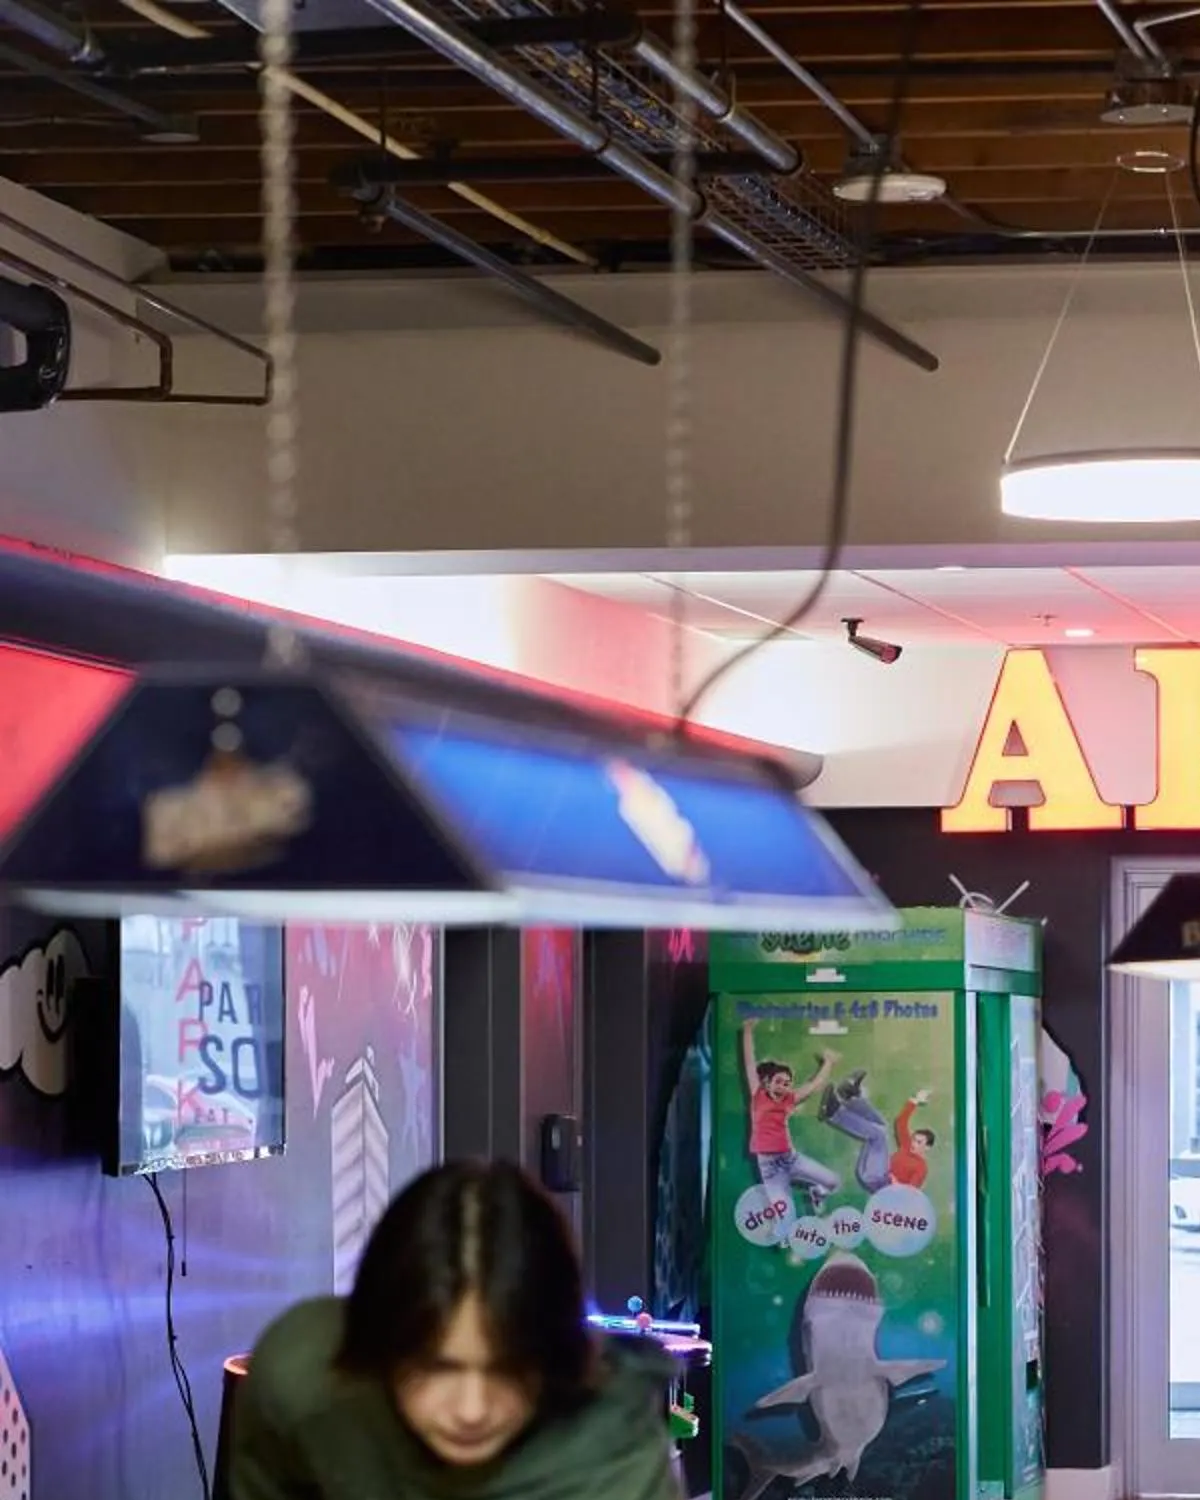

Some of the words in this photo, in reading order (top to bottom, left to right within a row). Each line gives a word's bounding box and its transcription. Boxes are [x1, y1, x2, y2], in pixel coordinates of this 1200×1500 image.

[197, 1034, 264, 1099] SO
[745, 1200, 787, 1232] drop
[833, 1219, 861, 1236] the
